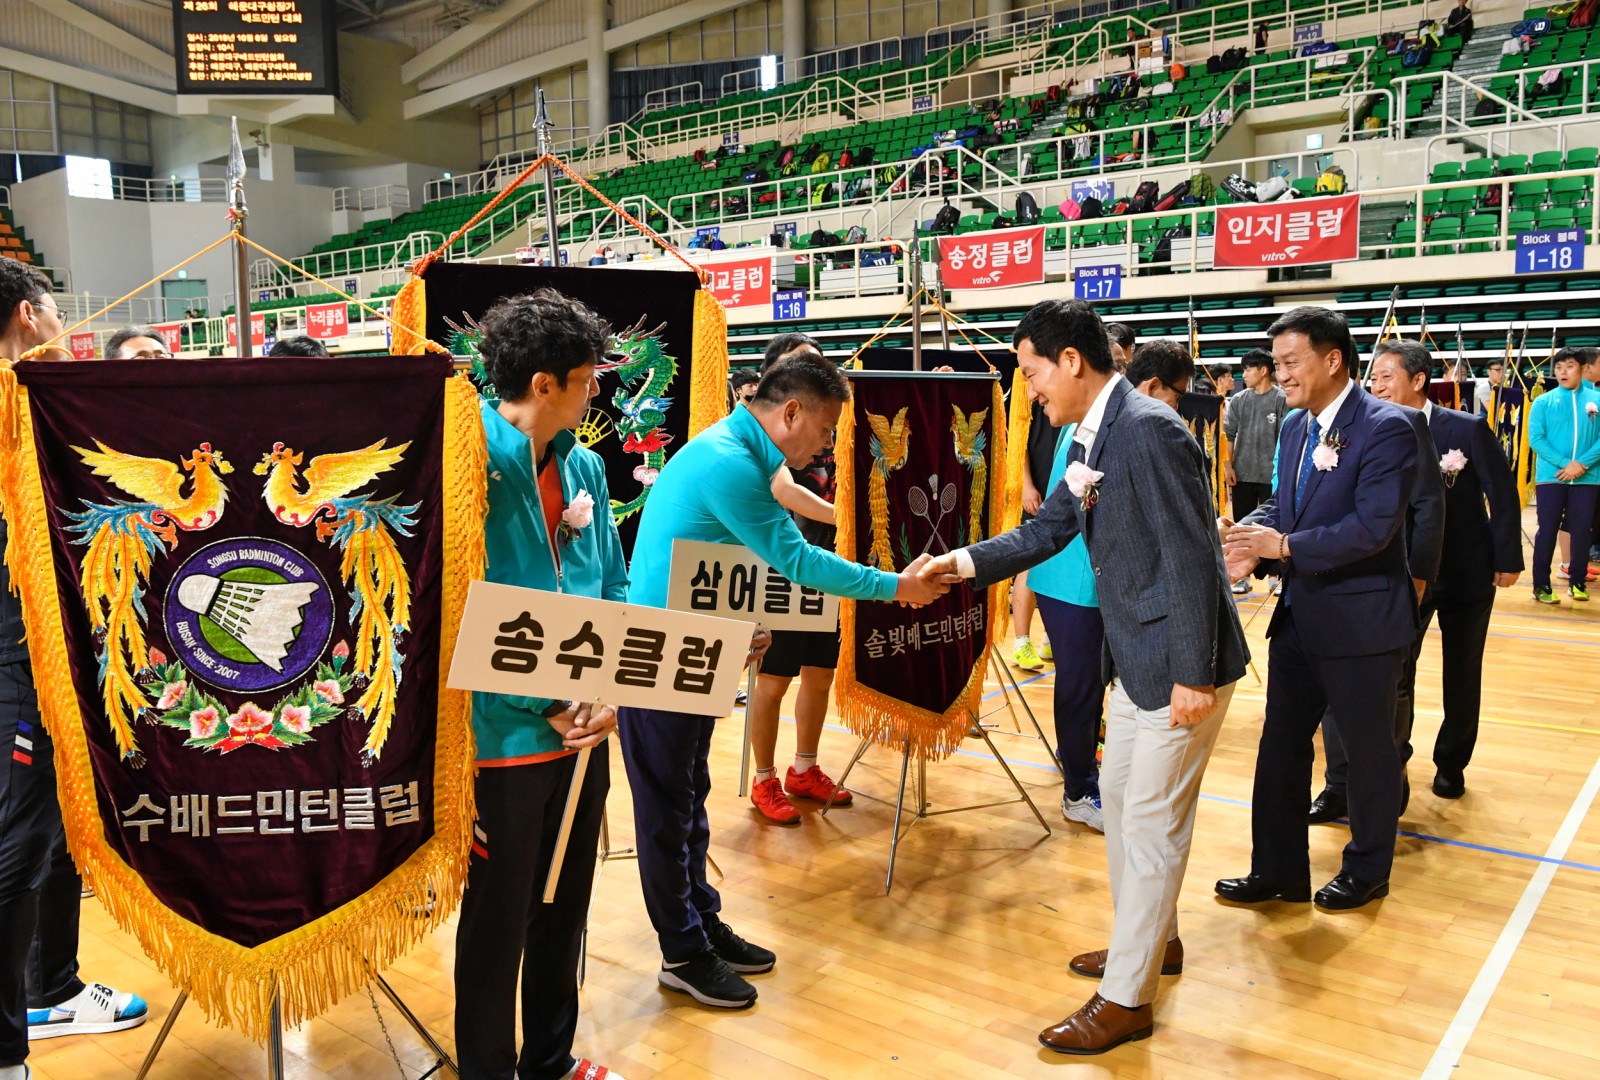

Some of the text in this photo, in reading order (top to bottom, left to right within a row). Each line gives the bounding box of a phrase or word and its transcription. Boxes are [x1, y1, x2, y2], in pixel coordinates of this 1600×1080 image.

[241, 13, 302, 23] 배드민턴 대회
[274, 34, 297, 42] 일요일
[1227, 207, 1344, 245] 인지클럽
[1522, 234, 1550, 245] Block
[948, 238, 1033, 270] 송정클럽
[1261, 251, 1286, 262] vitro
[1528, 246, 1572, 271] 1-18
[972, 275, 991, 285] vitro
[1080, 269, 1098, 278] Block
[1082, 280, 1112, 298] 1-17
[309, 308, 344, 327] 누리클럽
[778, 302, 800, 318] 1-16
[207, 549, 304, 578] SONGSU BADMINTON CLUB
[690, 560, 824, 615] 삼어클럽
[176, 621, 240, 680] BUSAN SINCE 2007
[490, 611, 723, 695] 송수클럽
[121, 780, 420, 842] 수배드민턴클럽
